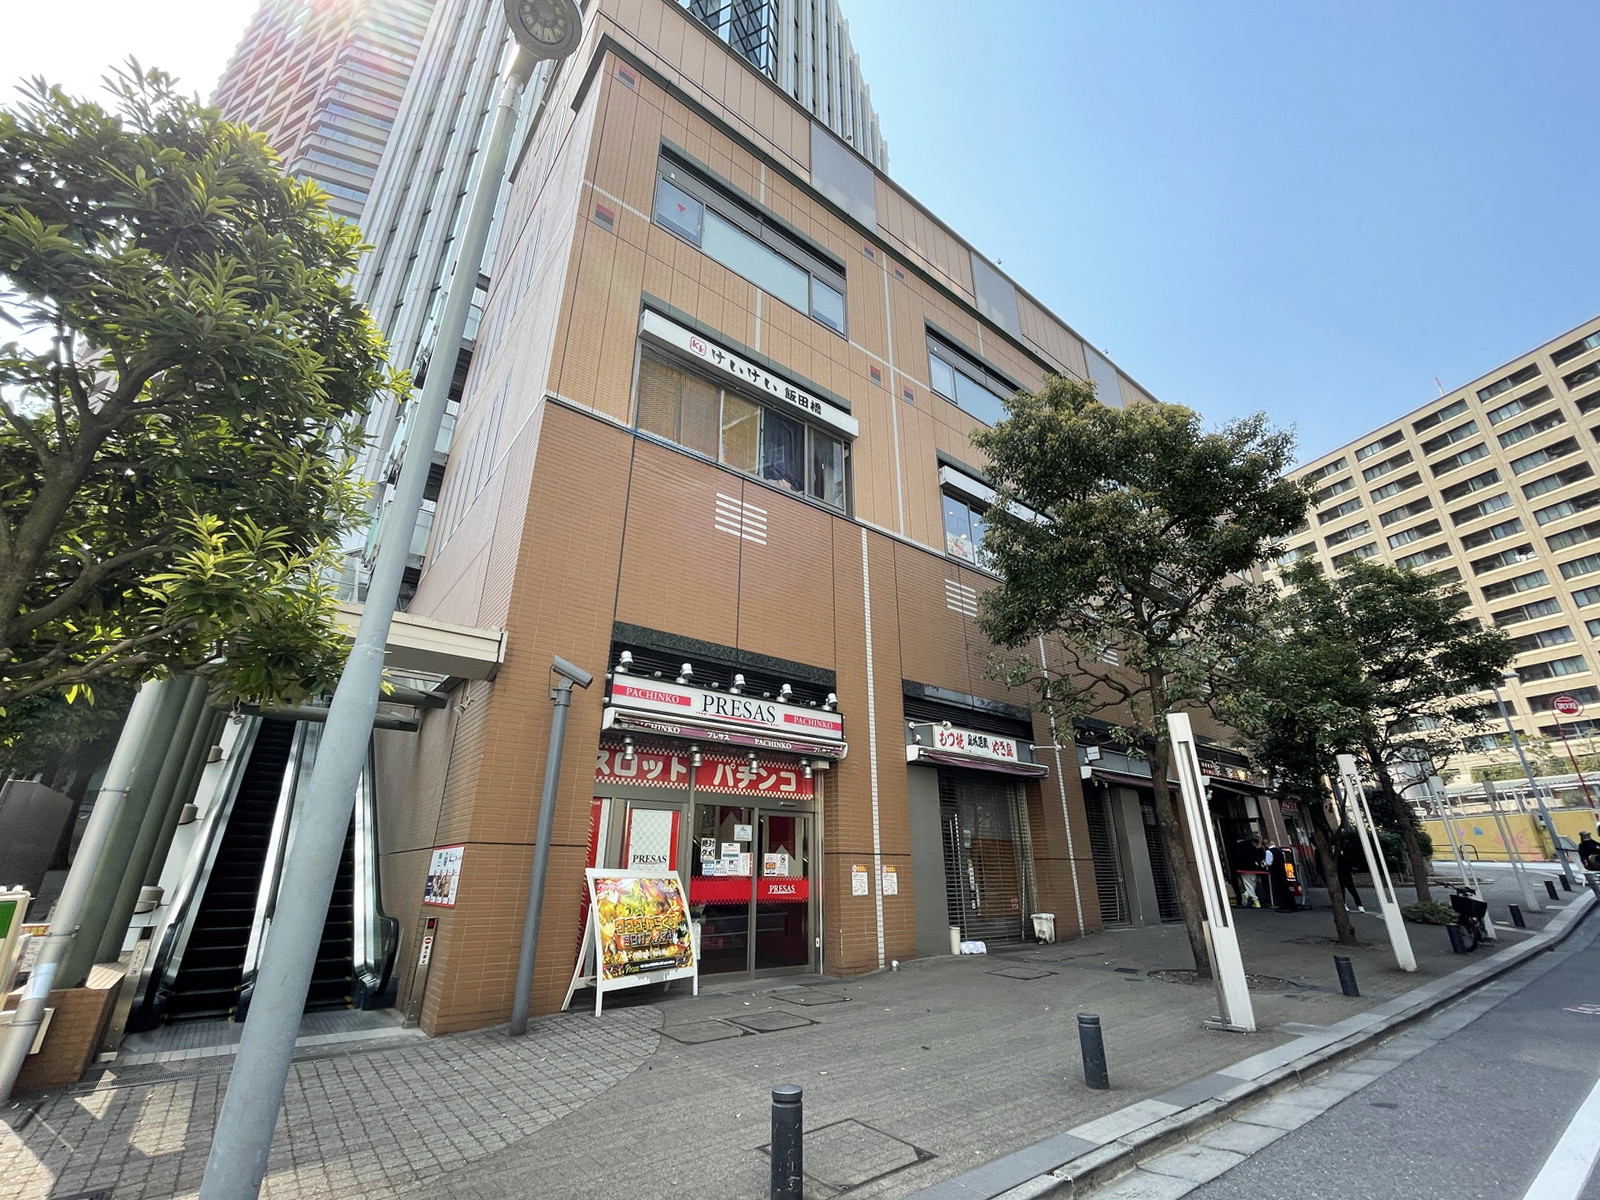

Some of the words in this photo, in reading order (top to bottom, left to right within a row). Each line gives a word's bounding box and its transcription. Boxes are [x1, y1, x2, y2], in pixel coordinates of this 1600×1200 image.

[711, 348, 778, 392] けいけい
[784, 386, 822, 416] 飯田橋
[625, 687, 680, 704] PACHINKO
[702, 694, 776, 724] PRESAS
[793, 716, 834, 730] PACHINKO
[707, 731, 731, 742] プレサス
[754, 738, 793, 750] PACHINKO
[597, 750, 687, 782] スロット
[712, 763, 797, 792] パチンコ
[632, 854, 668, 864] PRESAS
[769, 884, 797, 894] PRESAS
